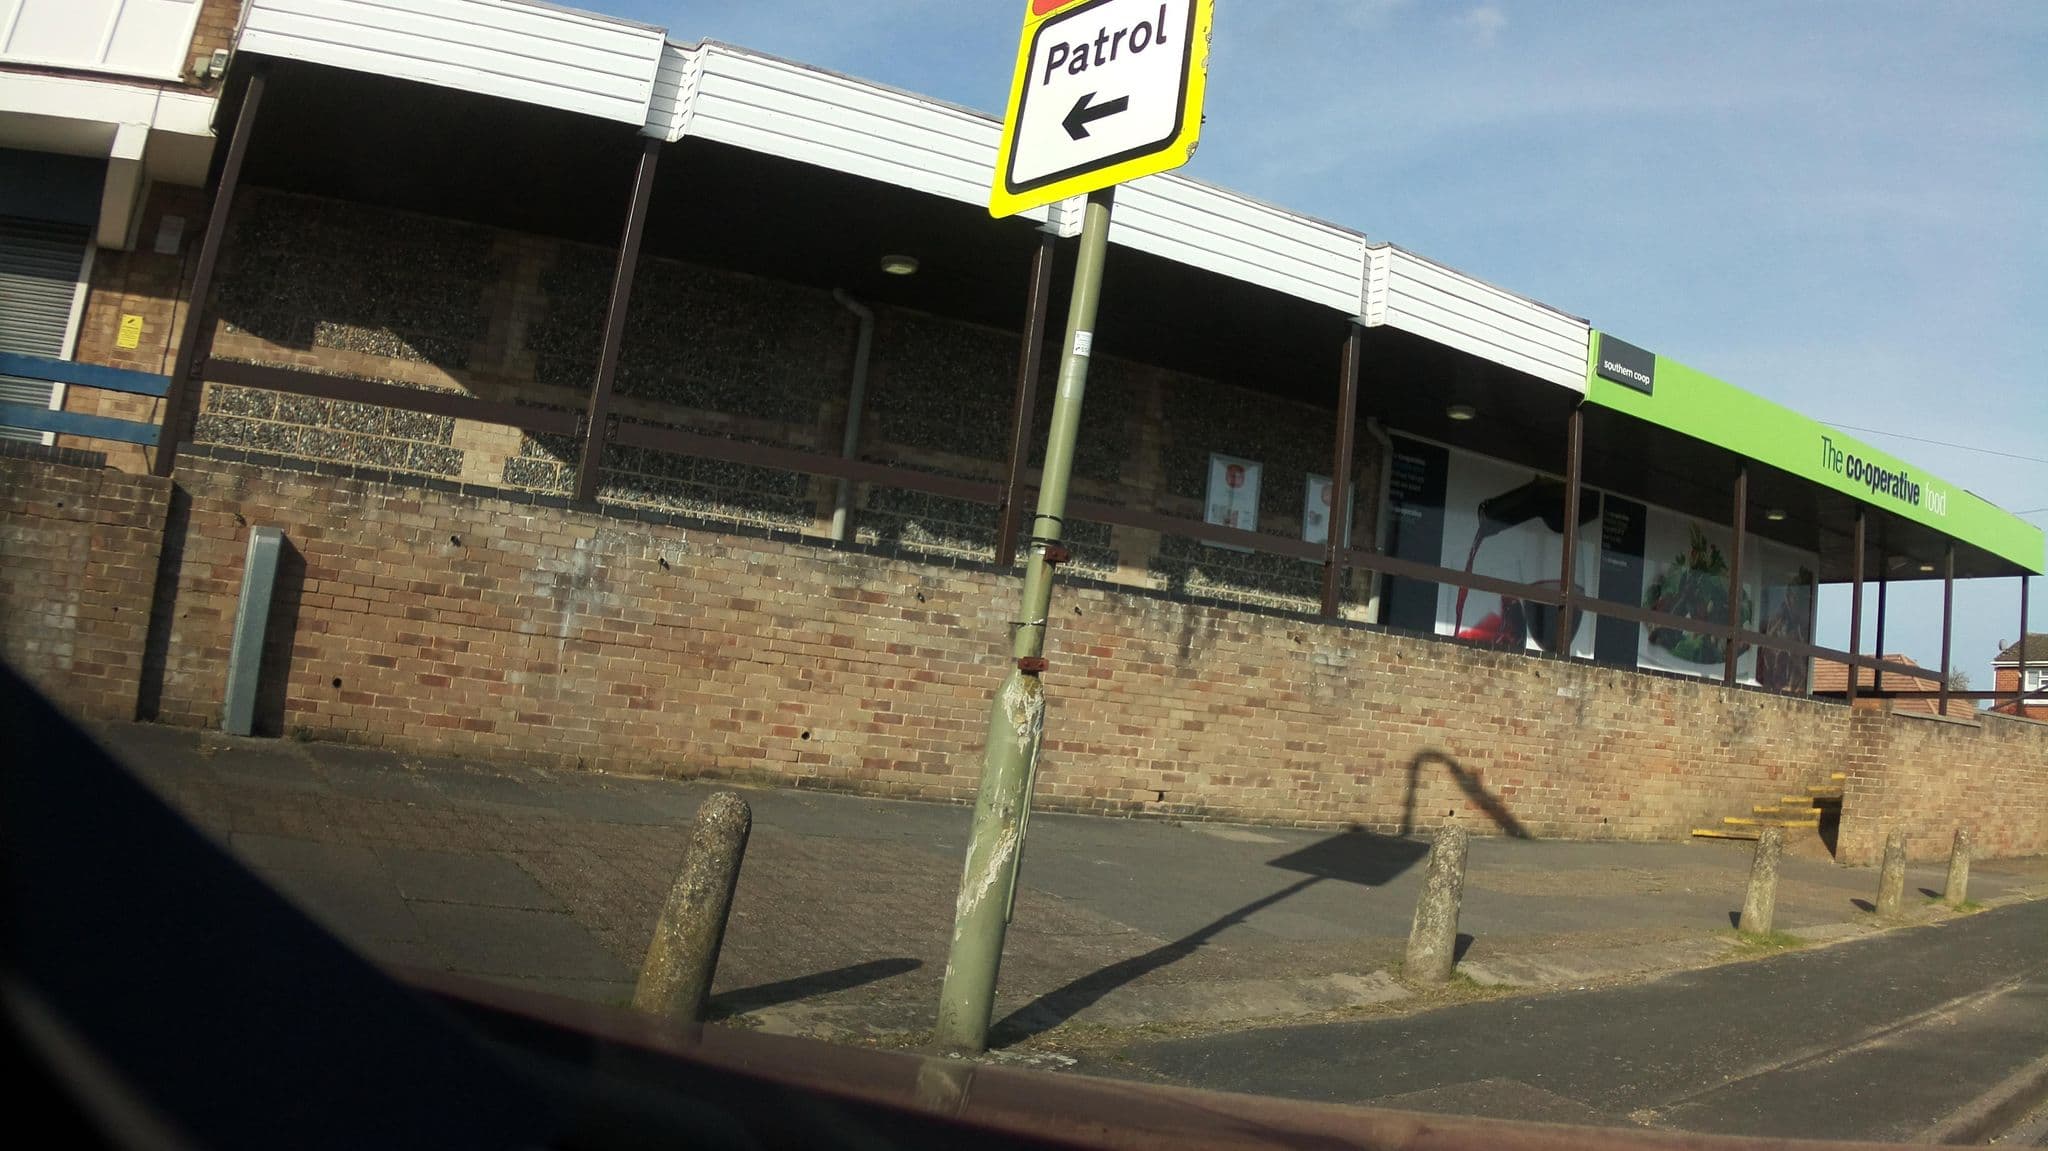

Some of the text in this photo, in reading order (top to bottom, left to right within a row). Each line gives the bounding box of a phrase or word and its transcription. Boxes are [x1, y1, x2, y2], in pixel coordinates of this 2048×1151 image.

[1043, 4, 1167, 86] Patrol
[1604, 360, 1633, 378] southern
[1821, 435, 1843, 474] The
[1925, 482, 1946, 516] food
